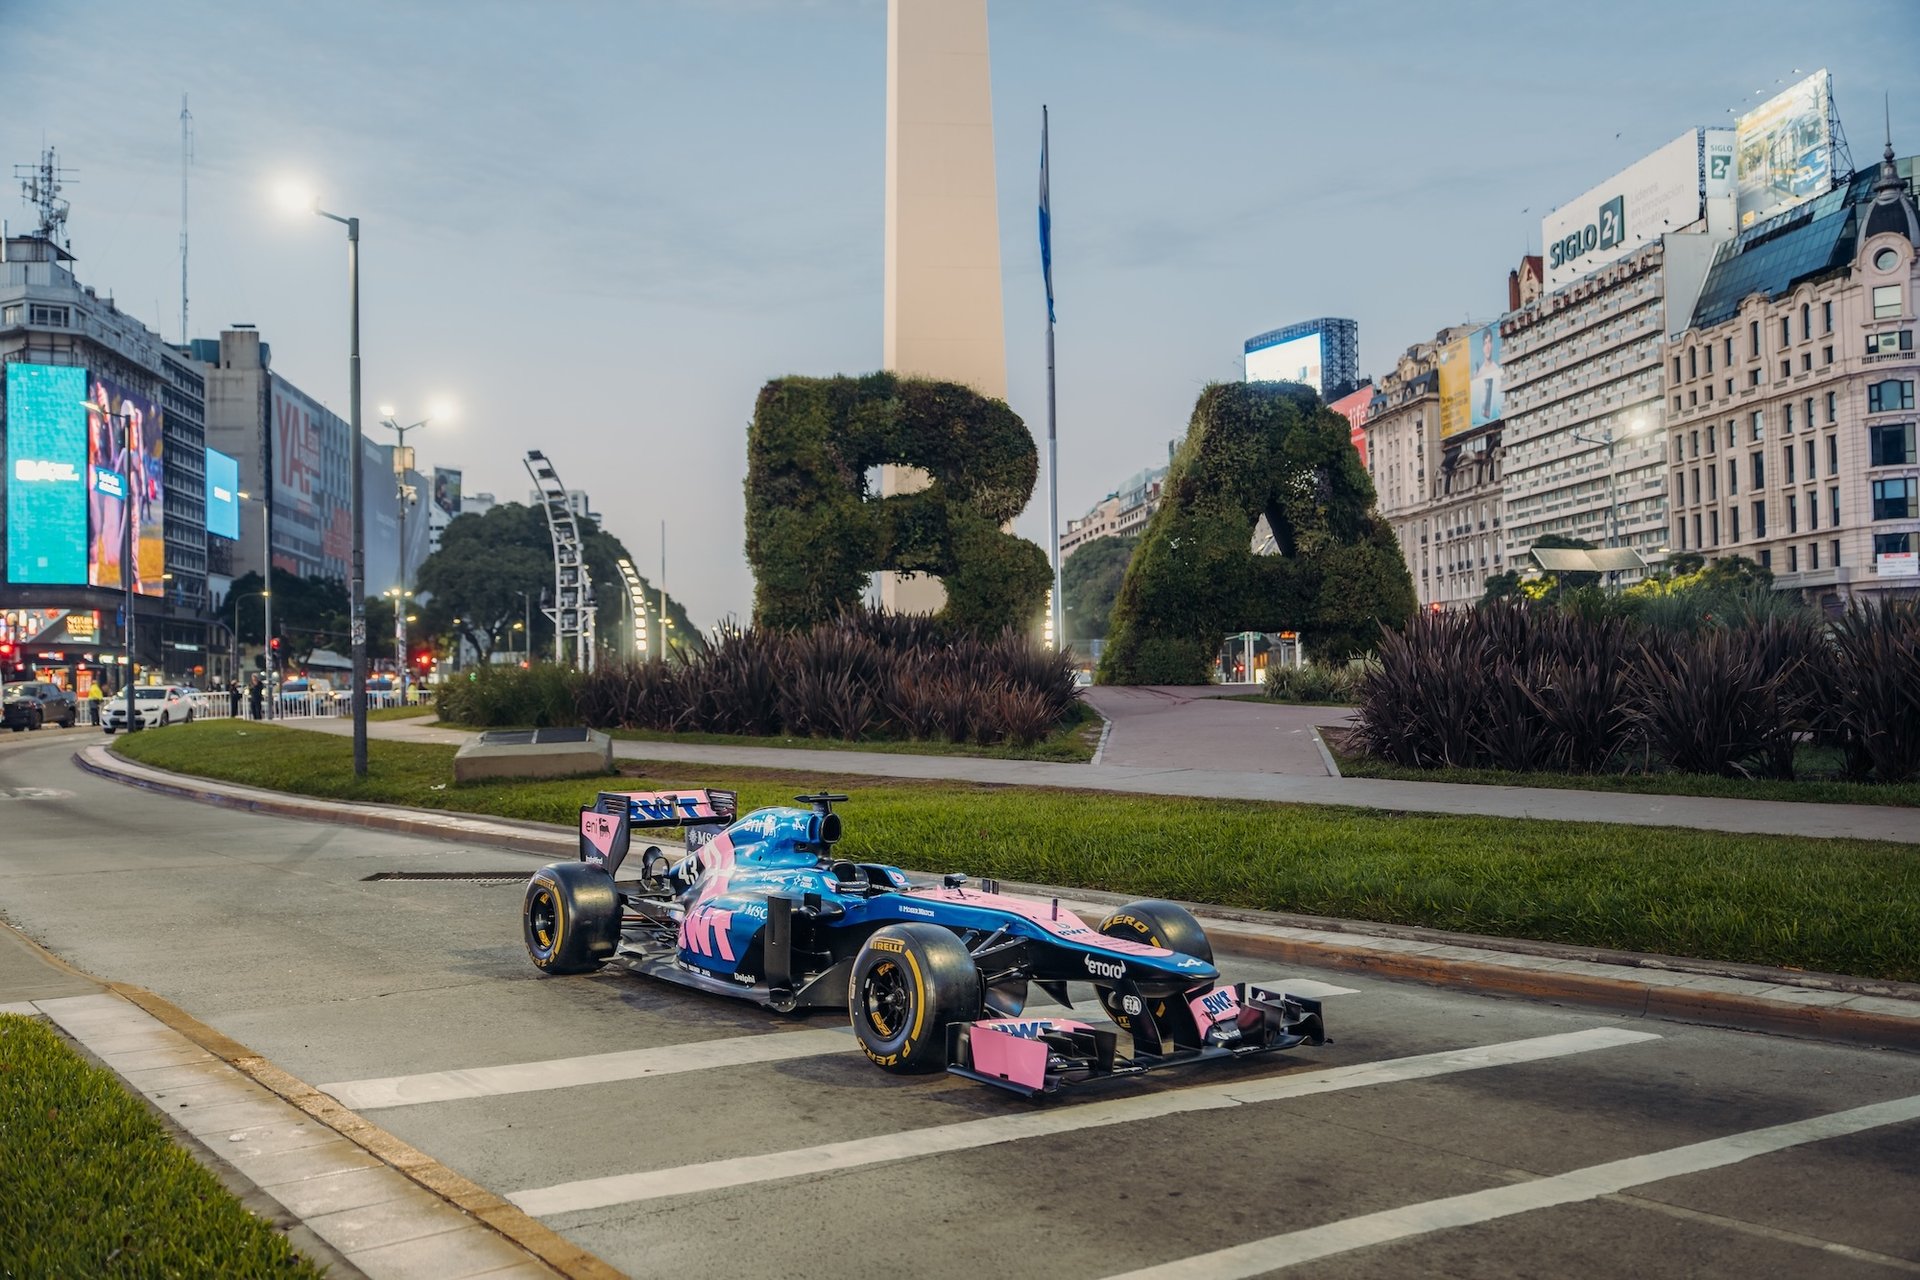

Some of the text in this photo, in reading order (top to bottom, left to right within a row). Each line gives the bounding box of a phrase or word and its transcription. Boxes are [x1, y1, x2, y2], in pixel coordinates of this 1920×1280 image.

[1710, 144, 1733, 152] SIGLO
[1549, 223, 1598, 269] SIGLO
[585, 819, 598, 833] eni
[745, 815, 765, 838] eni
[678, 855, 699, 885] 43
[745, 904, 768, 919] MSC
[1058, 928, 1088, 936] BWT
[1102, 914, 1150, 934] ZERO
[870, 936, 905, 954] PIRELLI
[734, 972, 756, 984] Delphi
[1123, 998, 1140, 1011] FIA
[1201, 990, 1233, 1016] BWT
[858, 1037, 912, 1066] P ZERO
